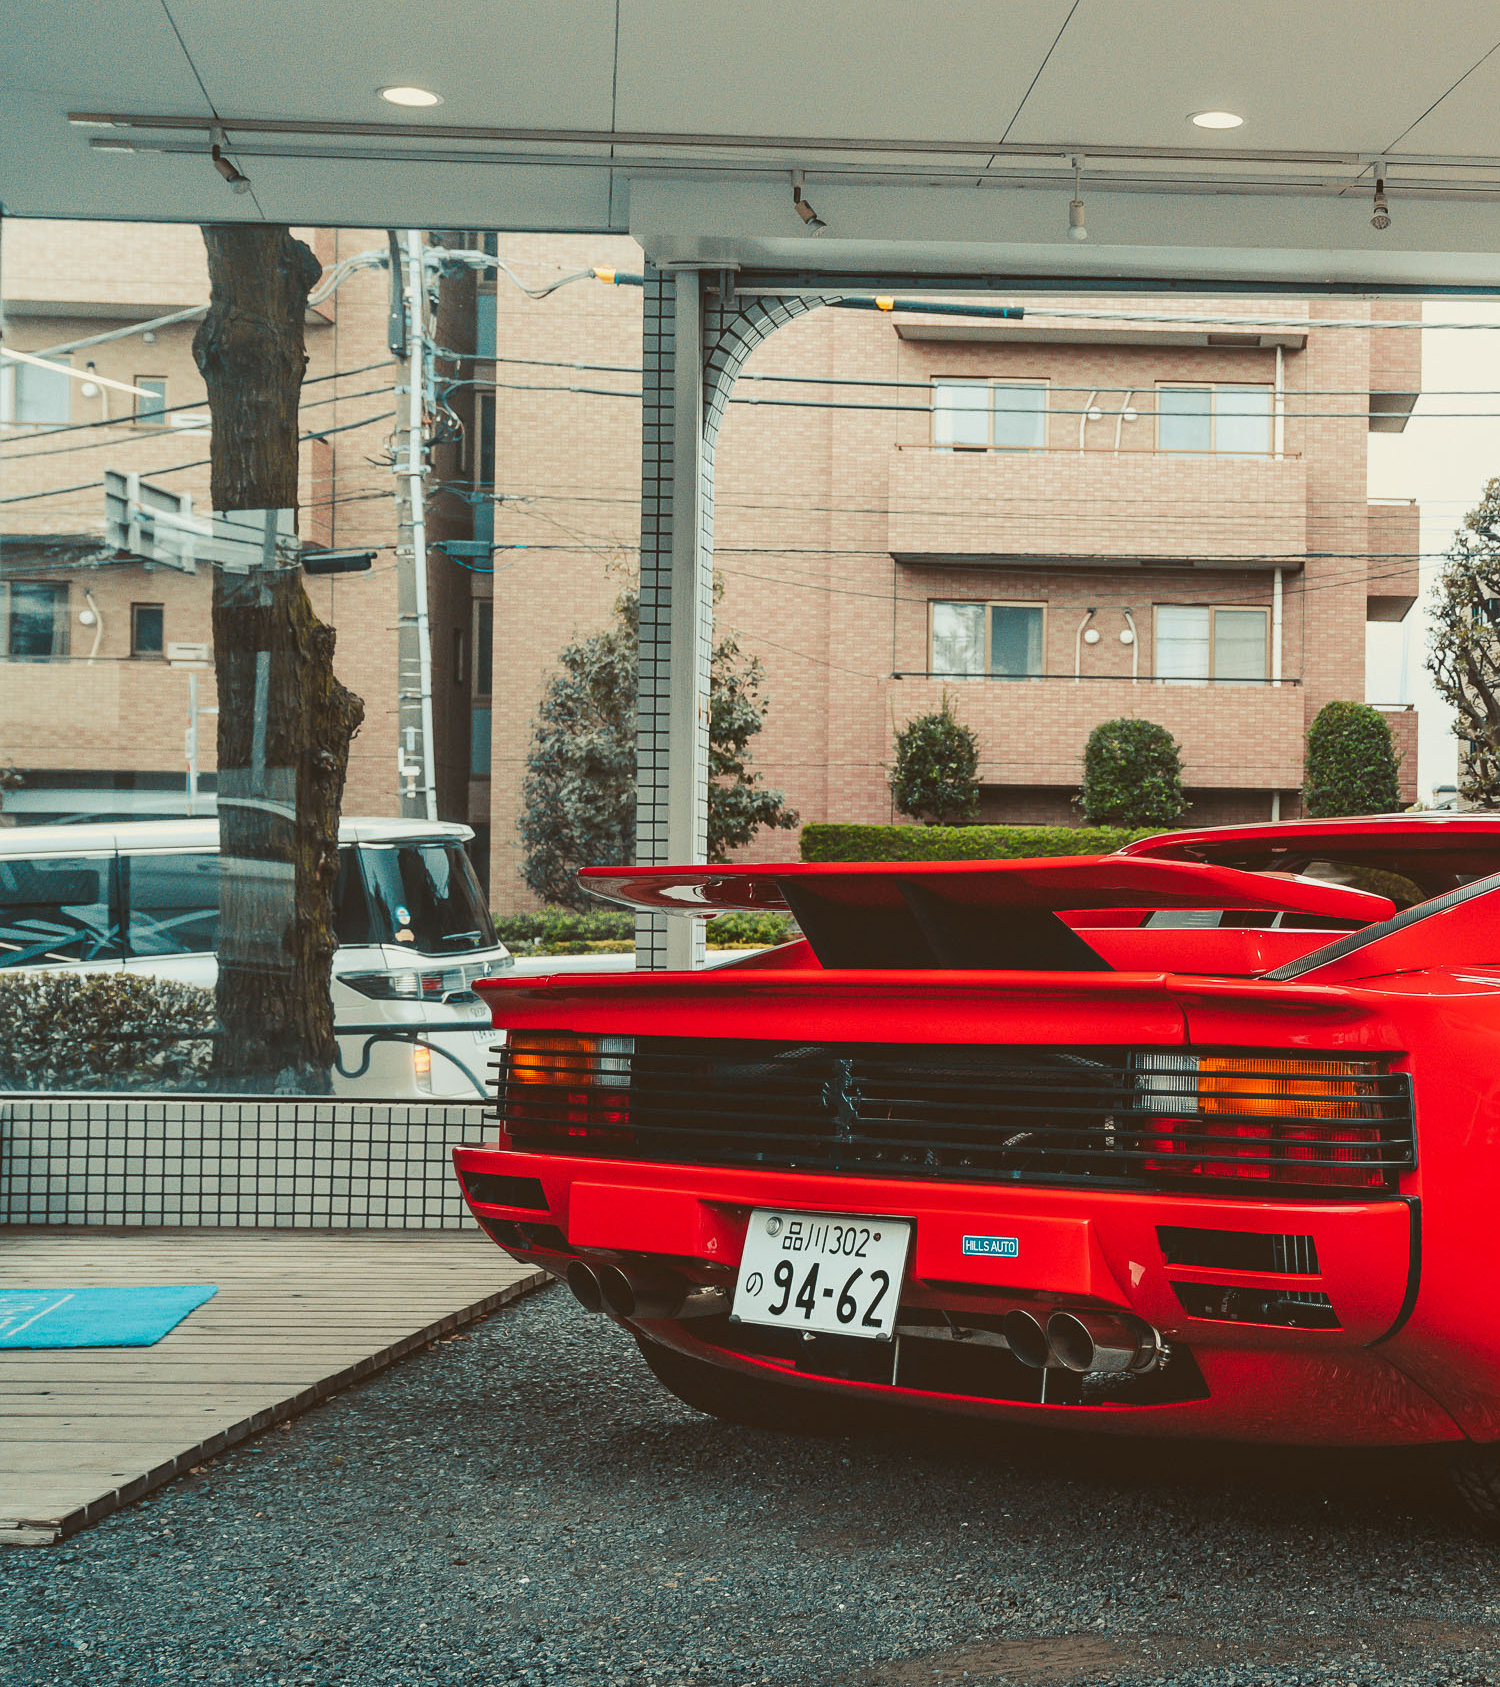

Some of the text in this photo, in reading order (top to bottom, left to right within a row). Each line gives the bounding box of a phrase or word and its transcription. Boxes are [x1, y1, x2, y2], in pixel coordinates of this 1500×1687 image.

[966, 1240, 1015, 1253] HILLS AUTO
[745, 1260, 890, 1328] の 94-62
